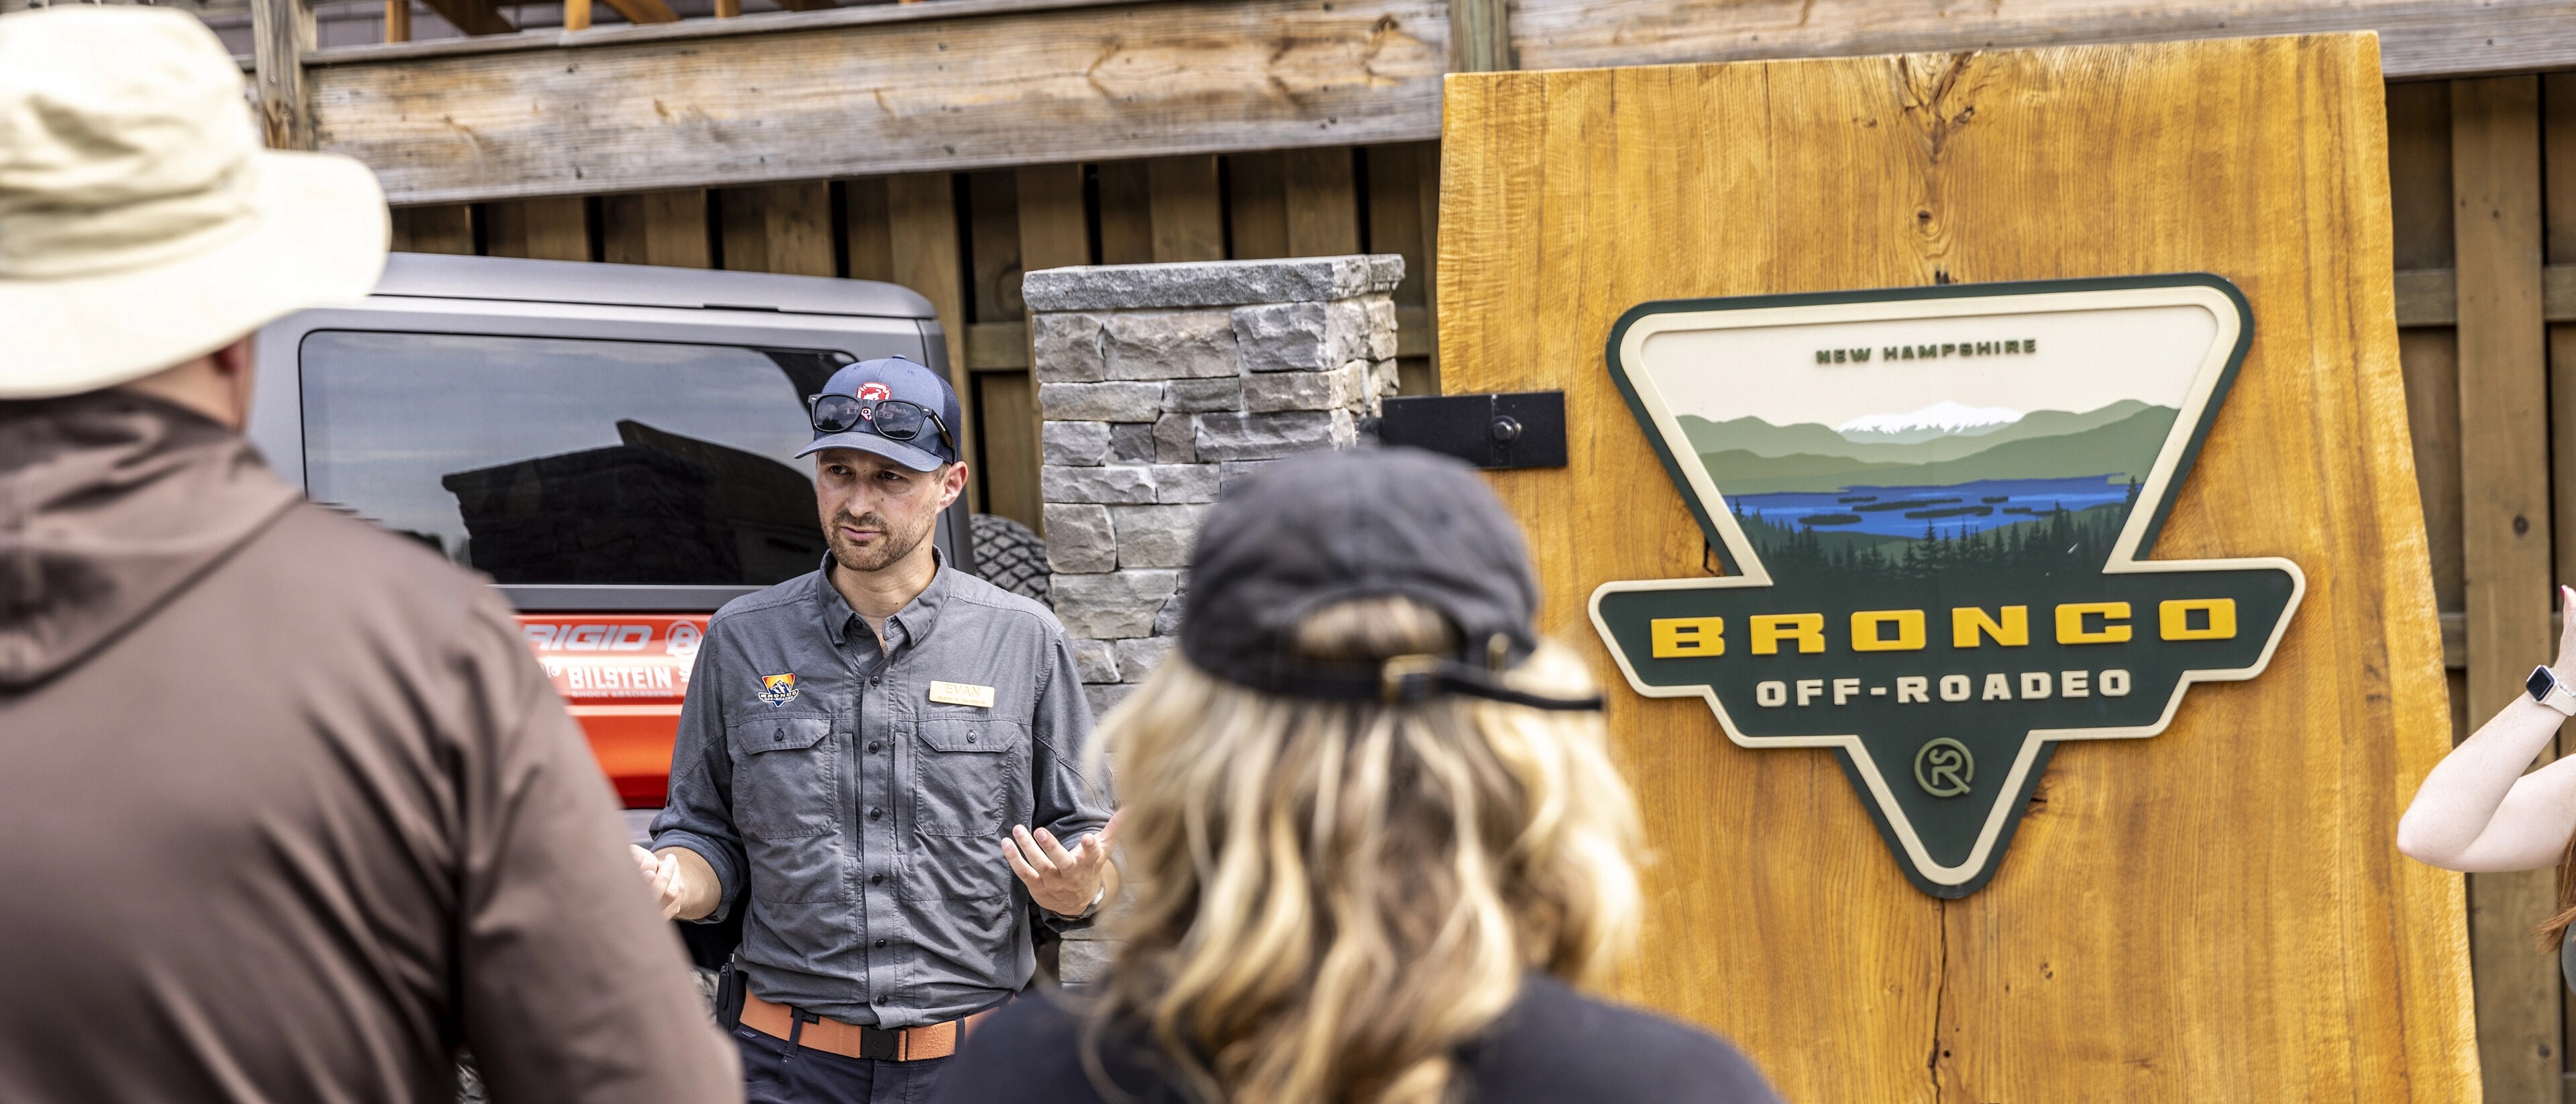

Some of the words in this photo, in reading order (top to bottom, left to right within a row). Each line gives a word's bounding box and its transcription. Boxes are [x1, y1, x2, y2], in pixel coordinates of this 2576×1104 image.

[1816, 348, 1872, 364] NEW
[1883, 339, 2036, 360] HAMPSHIRE
[523, 624, 653, 651] RIGID
[1651, 598, 2237, 659] BRONCO
[567, 665, 674, 689] BILSTEIN
[945, 683, 981, 696] EVAN
[1756, 669, 2131, 708] OFF-ROADEO
[572, 690, 608, 698] SHOCK
[611, 690, 674, 698] ABSORBERS
